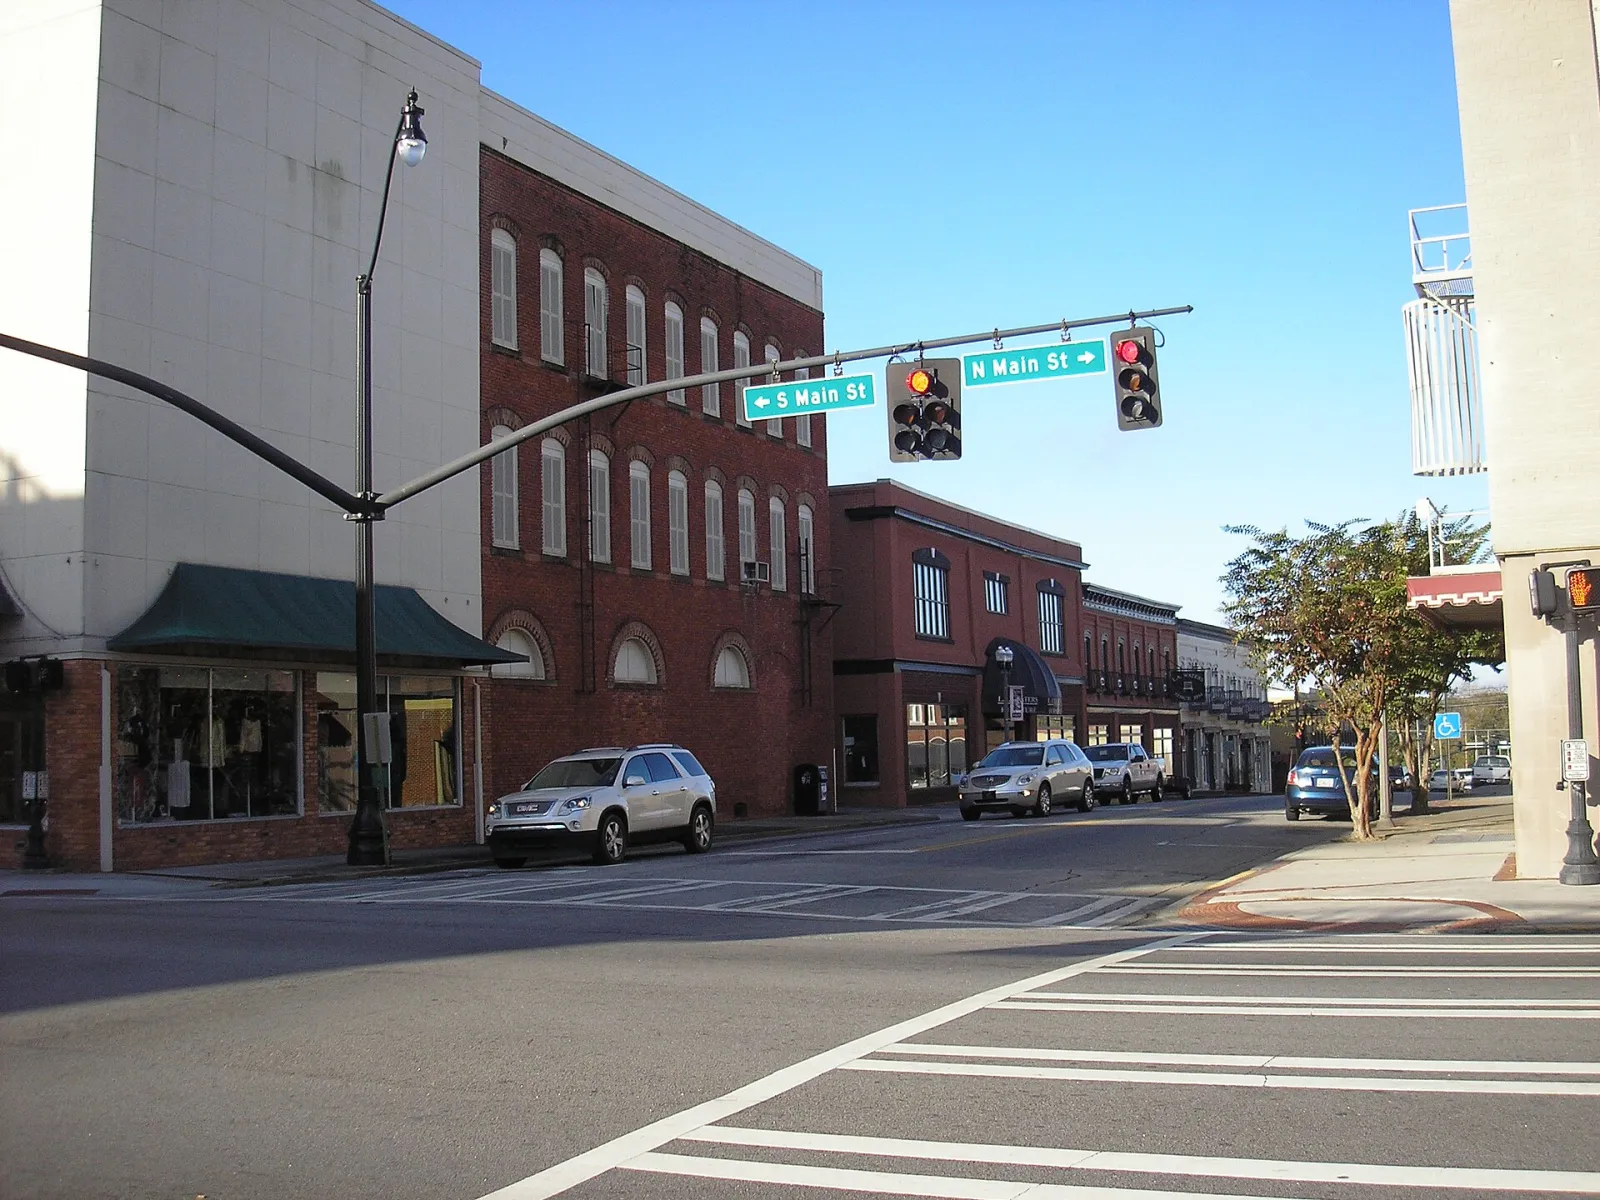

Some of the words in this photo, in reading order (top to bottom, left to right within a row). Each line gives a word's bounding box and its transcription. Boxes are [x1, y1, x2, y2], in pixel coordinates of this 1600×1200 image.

[971, 360, 986, 380] N
[992, 355, 1039, 377] Main
[1047, 351, 1068, 371] St
[776, 391, 789, 409] S
[795, 386, 839, 407] Main
[846, 382, 867, 401] St
[516, 804, 539, 812] GMC
